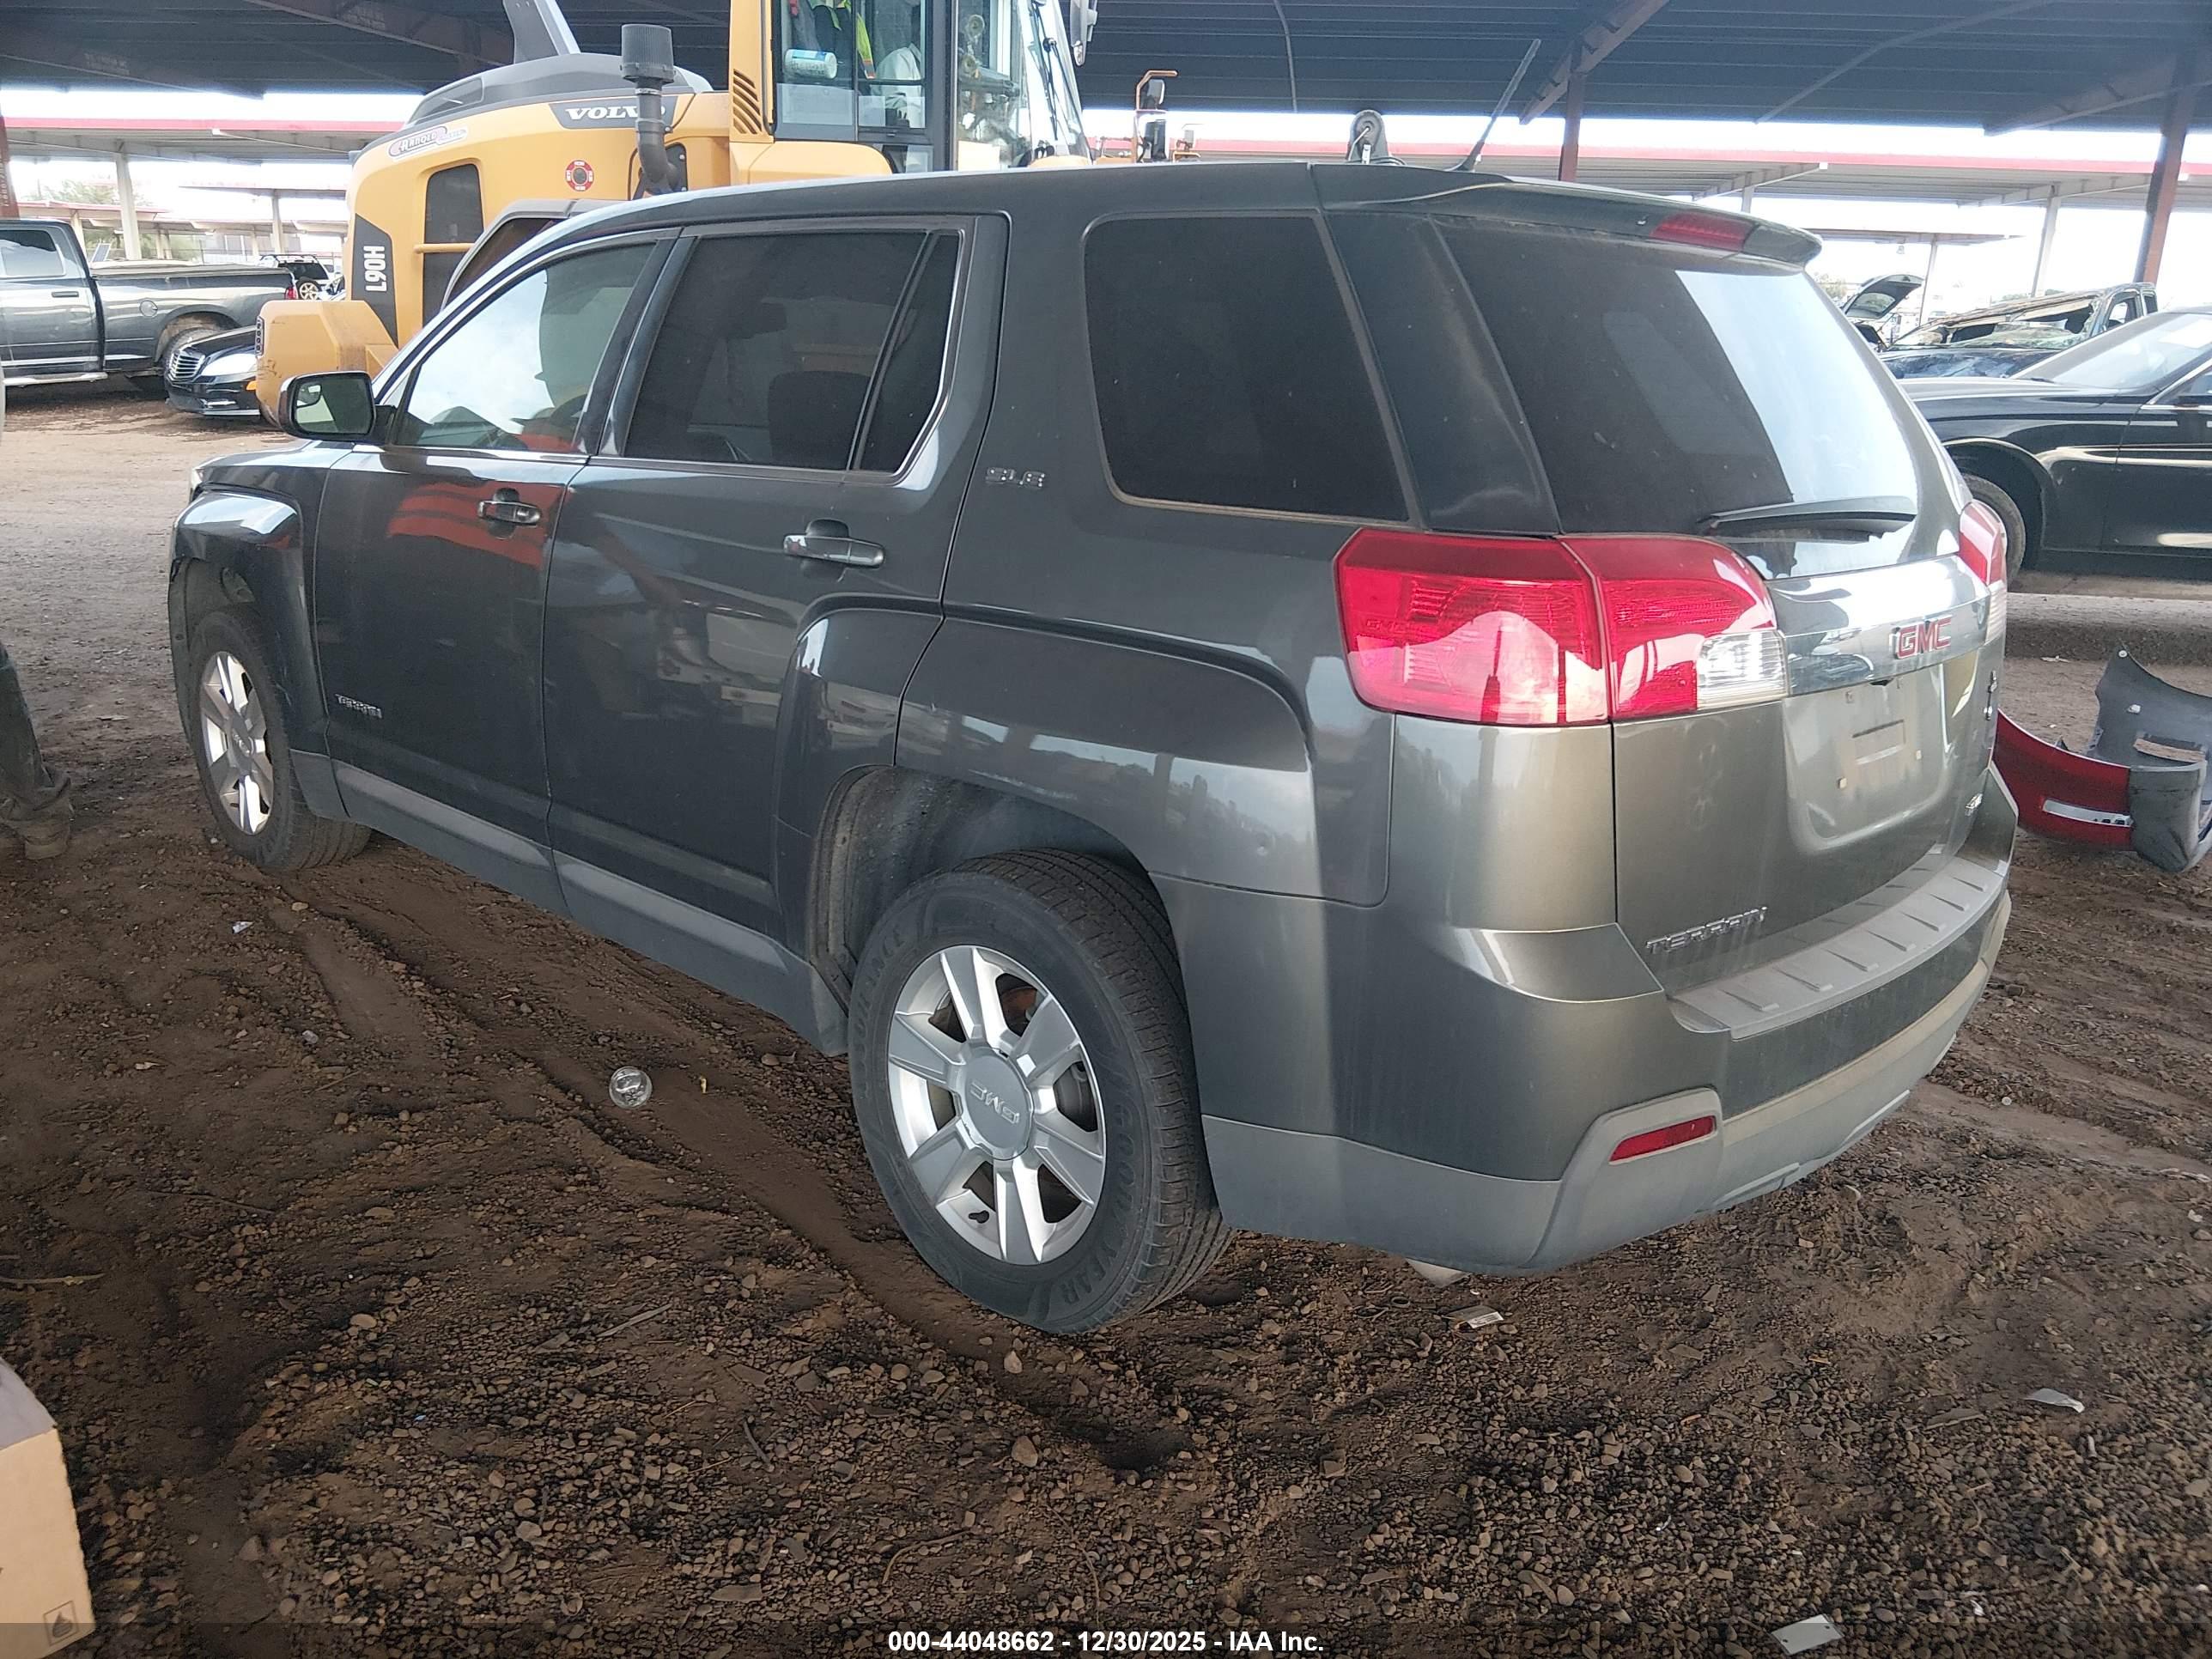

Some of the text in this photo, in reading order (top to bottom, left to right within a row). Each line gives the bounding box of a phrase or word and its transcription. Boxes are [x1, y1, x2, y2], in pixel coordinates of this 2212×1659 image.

[565, 106, 665, 120] VOLV
[363, 246, 387, 291] L90H
[1894, 616, 1953, 659] GMC
[970, 1082, 1019, 1124] GMC
